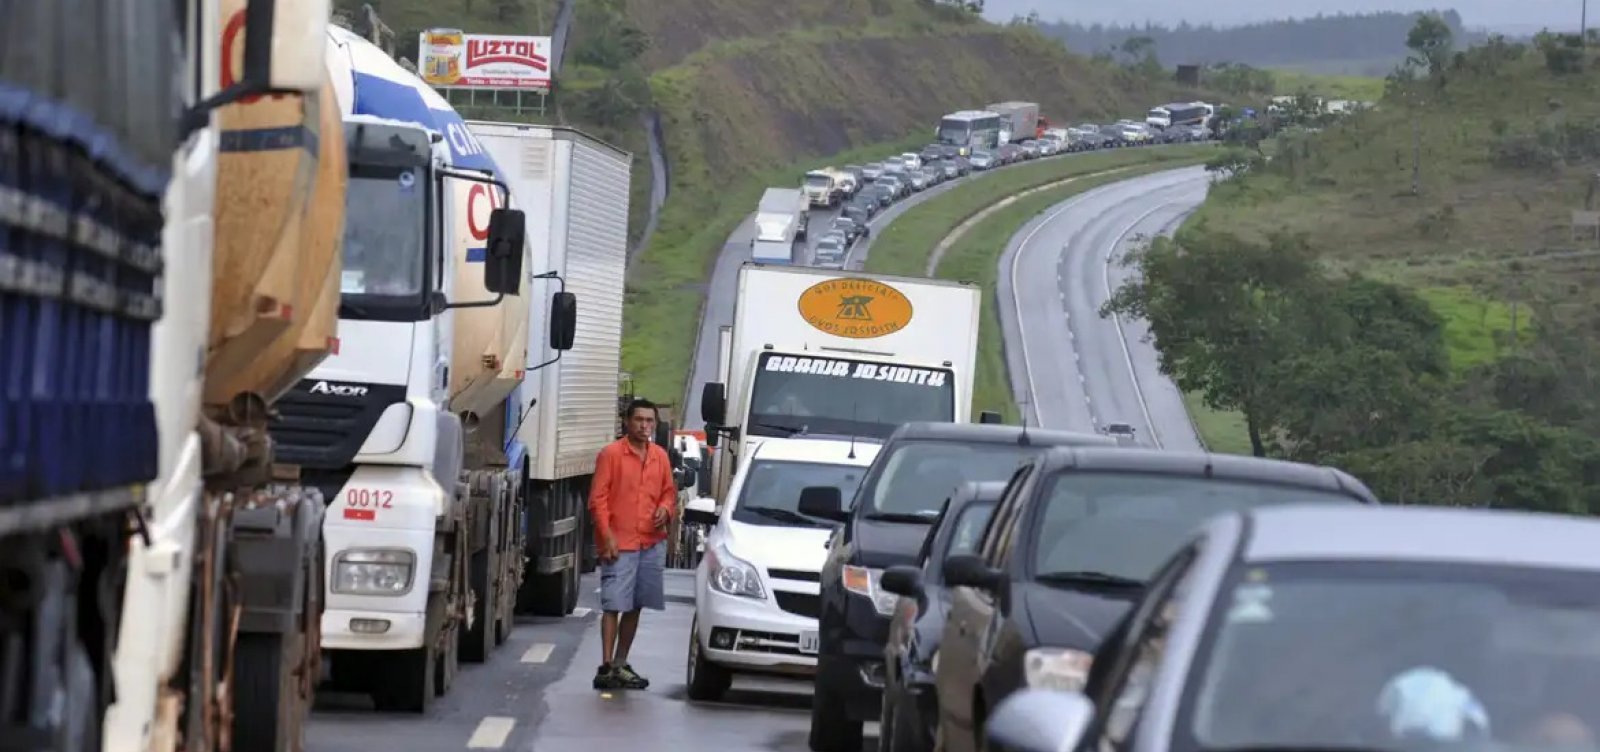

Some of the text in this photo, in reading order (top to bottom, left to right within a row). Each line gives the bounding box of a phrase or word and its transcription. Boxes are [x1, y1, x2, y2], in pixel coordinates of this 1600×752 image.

[466, 39, 547, 72] LUZTOL
[765, 355, 945, 387] GRANJA JOSIDITH
[348, 489, 393, 509] 0012
